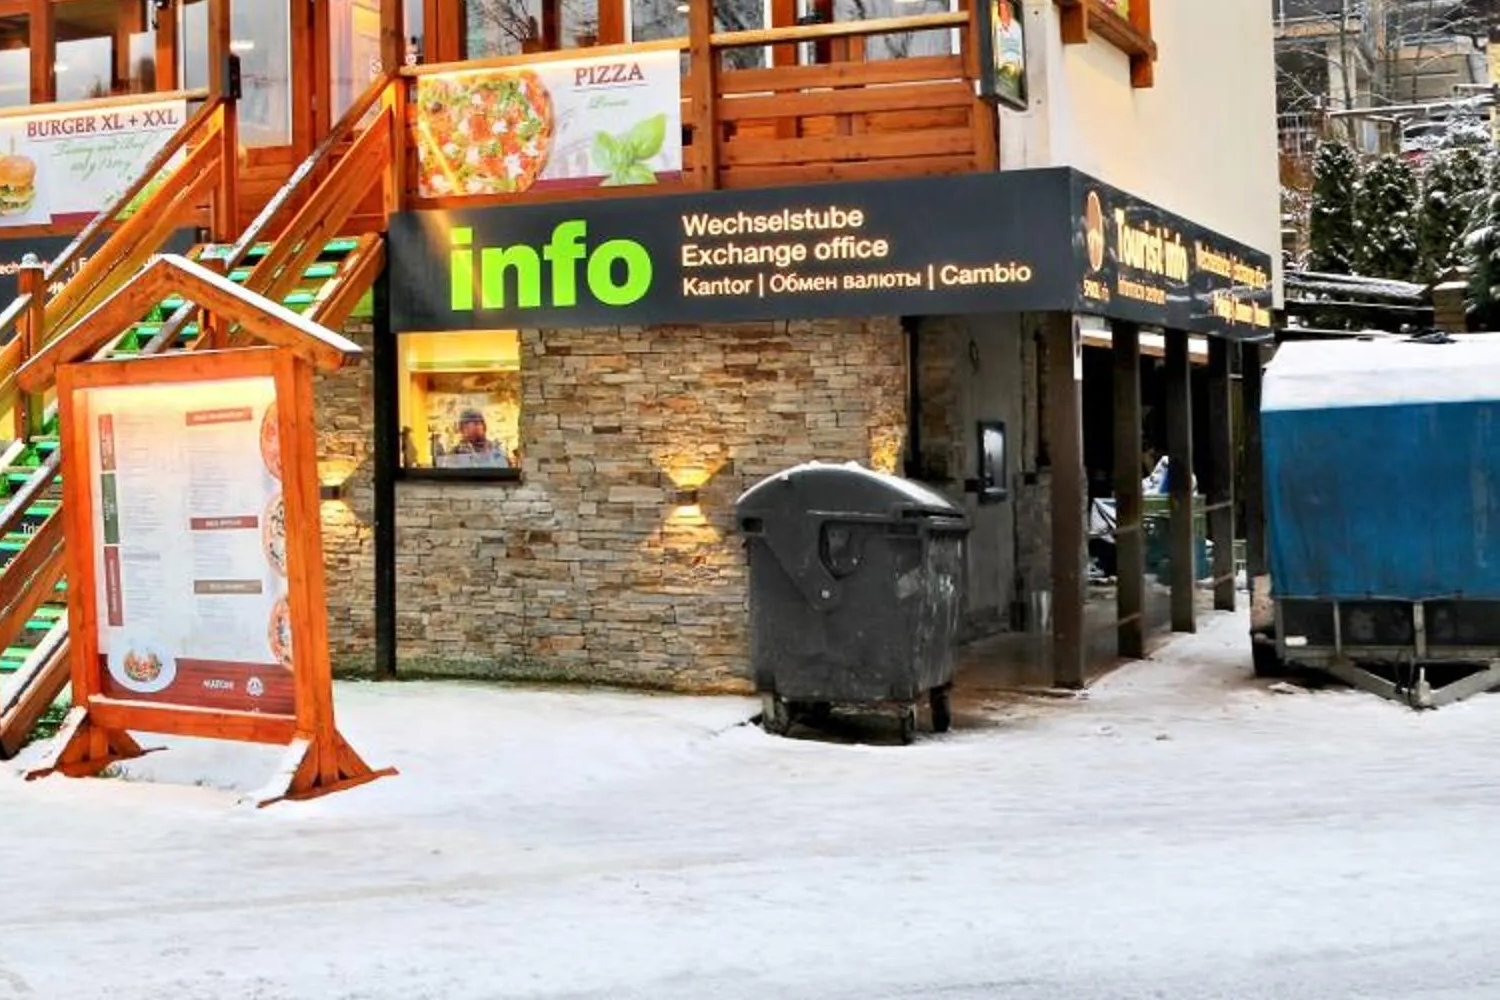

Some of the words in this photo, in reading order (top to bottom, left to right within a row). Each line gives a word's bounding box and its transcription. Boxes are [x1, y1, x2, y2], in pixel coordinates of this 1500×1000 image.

[574, 62, 644, 86] PIZZA
[27, 116, 96, 137] BURGER
[100, 113, 124, 131] XL
[143, 109, 178, 127] XXL
[682, 205, 865, 236] Wechselstube
[682, 241, 807, 267] Exchange
[814, 235, 889, 261] office
[1114, 207, 1164, 275] Tourist
[450, 220, 652, 310] info
[683, 276, 752, 296] Kantor
[769, 271, 837, 293] Обмен
[843, 271, 922, 290] валюты
[940, 262, 1032, 286] Cambio
